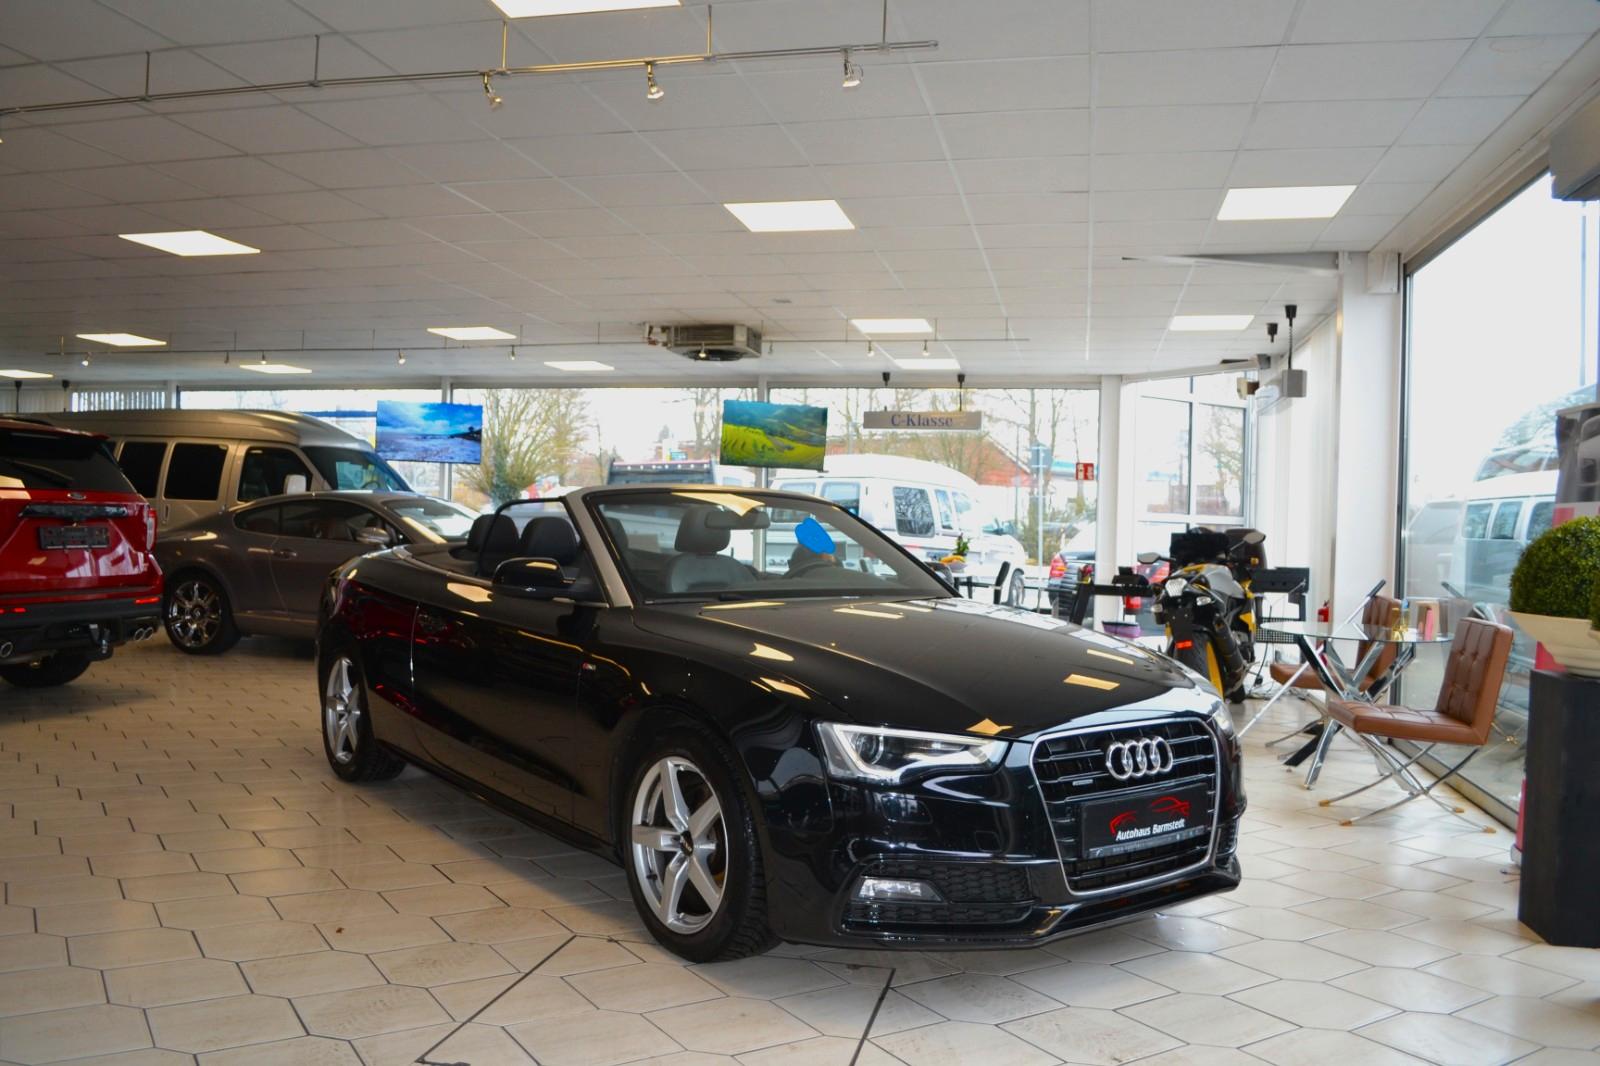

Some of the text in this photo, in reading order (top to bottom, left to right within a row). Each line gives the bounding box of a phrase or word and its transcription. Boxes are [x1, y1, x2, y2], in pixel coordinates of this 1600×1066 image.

[891, 413, 953, 427] C-Klasse
[1115, 817, 1186, 842] Autohaus Barmstedt
